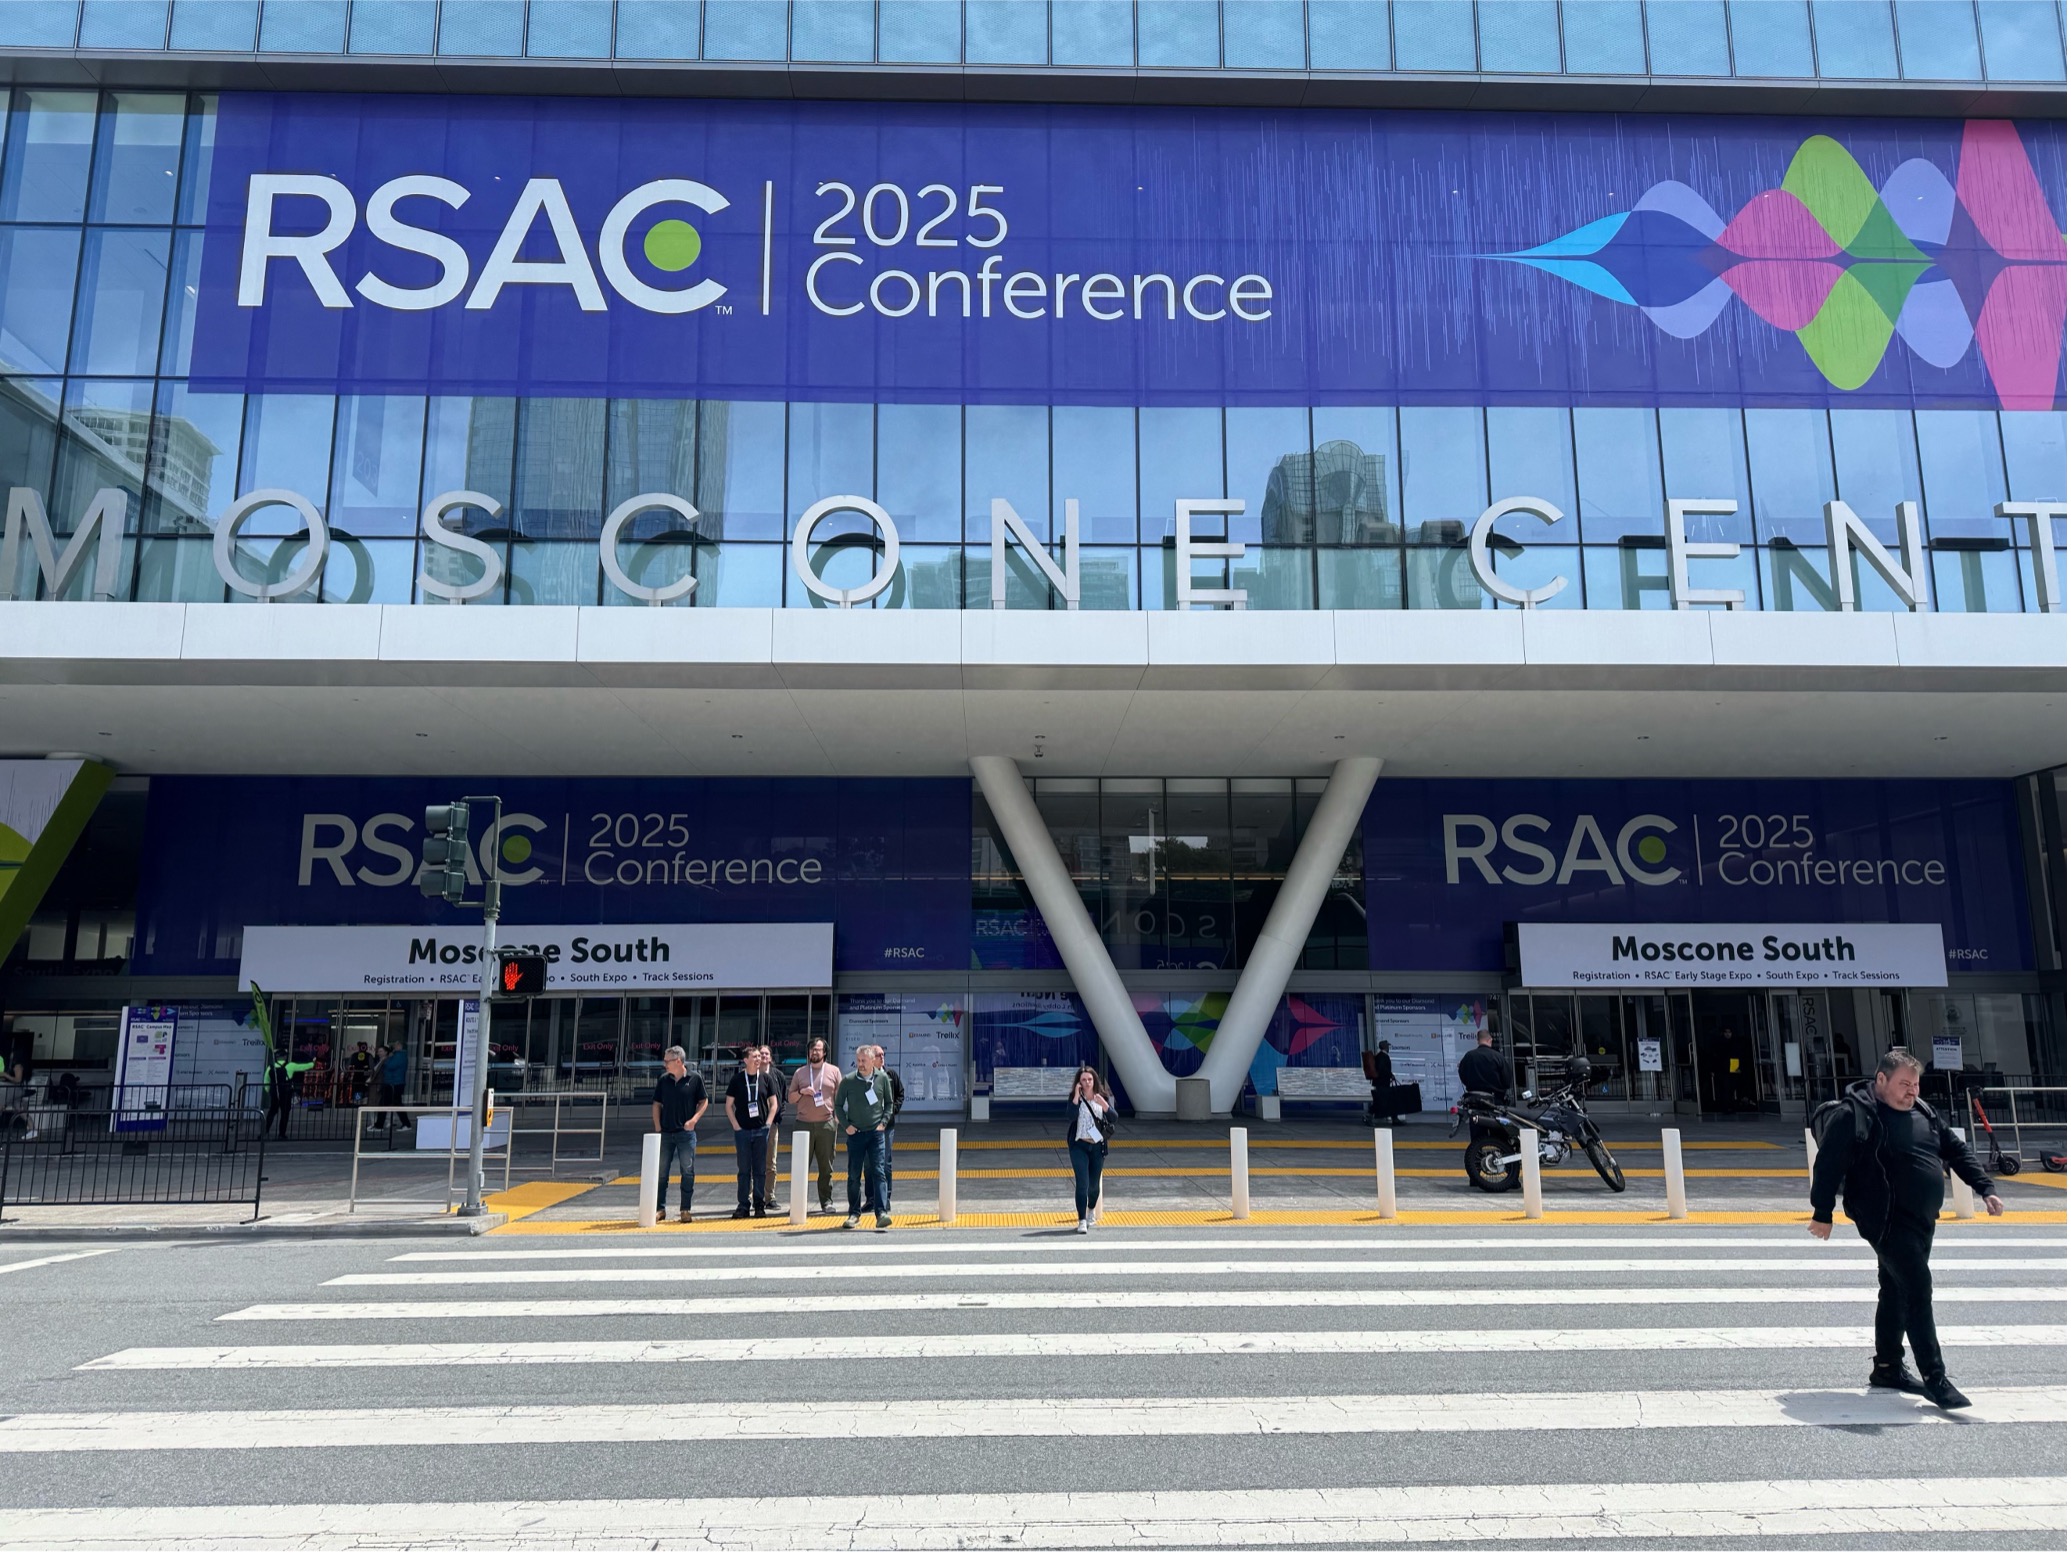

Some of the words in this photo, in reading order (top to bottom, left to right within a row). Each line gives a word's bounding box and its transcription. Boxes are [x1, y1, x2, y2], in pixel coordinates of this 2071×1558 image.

[812, 181, 1008, 247] 2025
[238, 173, 731, 314] RSAC
[805, 250, 1273, 320] Conference
[0, 487, 1247, 604] MOSCONE
[589, 812, 690, 848] 2025
[1717, 814, 1814, 848] 2025
[1442, 813, 1682, 886] RSAC
[584, 850, 822, 886] Conference
[1718, 851, 1945, 886] Conference
[408, 936, 561, 965] Mose
[570, 936, 670, 963] South
[883, 947, 925, 959] #RSAC
[1612, 935, 1754, 961] Moscone
[1762, 935, 1855, 961] South
[1948, 949, 1988, 960] #RSAC
[363, 974, 425, 985] Registration
[472, 974, 497, 985] Eay
[570, 973, 600, 983] South
[602, 973, 628, 984] Expo
[642, 972, 670, 982] Track
[672, 971, 714, 981] Sessions
[1573, 971, 1631, 982] Registration
[1675, 971, 1698, 981] Early
[1700, 971, 1727, 982] Stage
[1729, 971, 1752, 982] Expo
[1766, 971, 1794, 980] South
[1796, 971, 1820, 982] Expo
[1832, 971, 1858, 980] Track
[1860, 971, 1900, 980] Sessions
[936, 1031, 960, 1039] Trellix
[1458, 1032, 1478, 1040] Trelli
[502, 1044, 519, 1052] Only
[597, 1042, 614, 1051] Only
[644, 1042, 661, 1051] Only
[783, 1039, 800, 1047] Only
